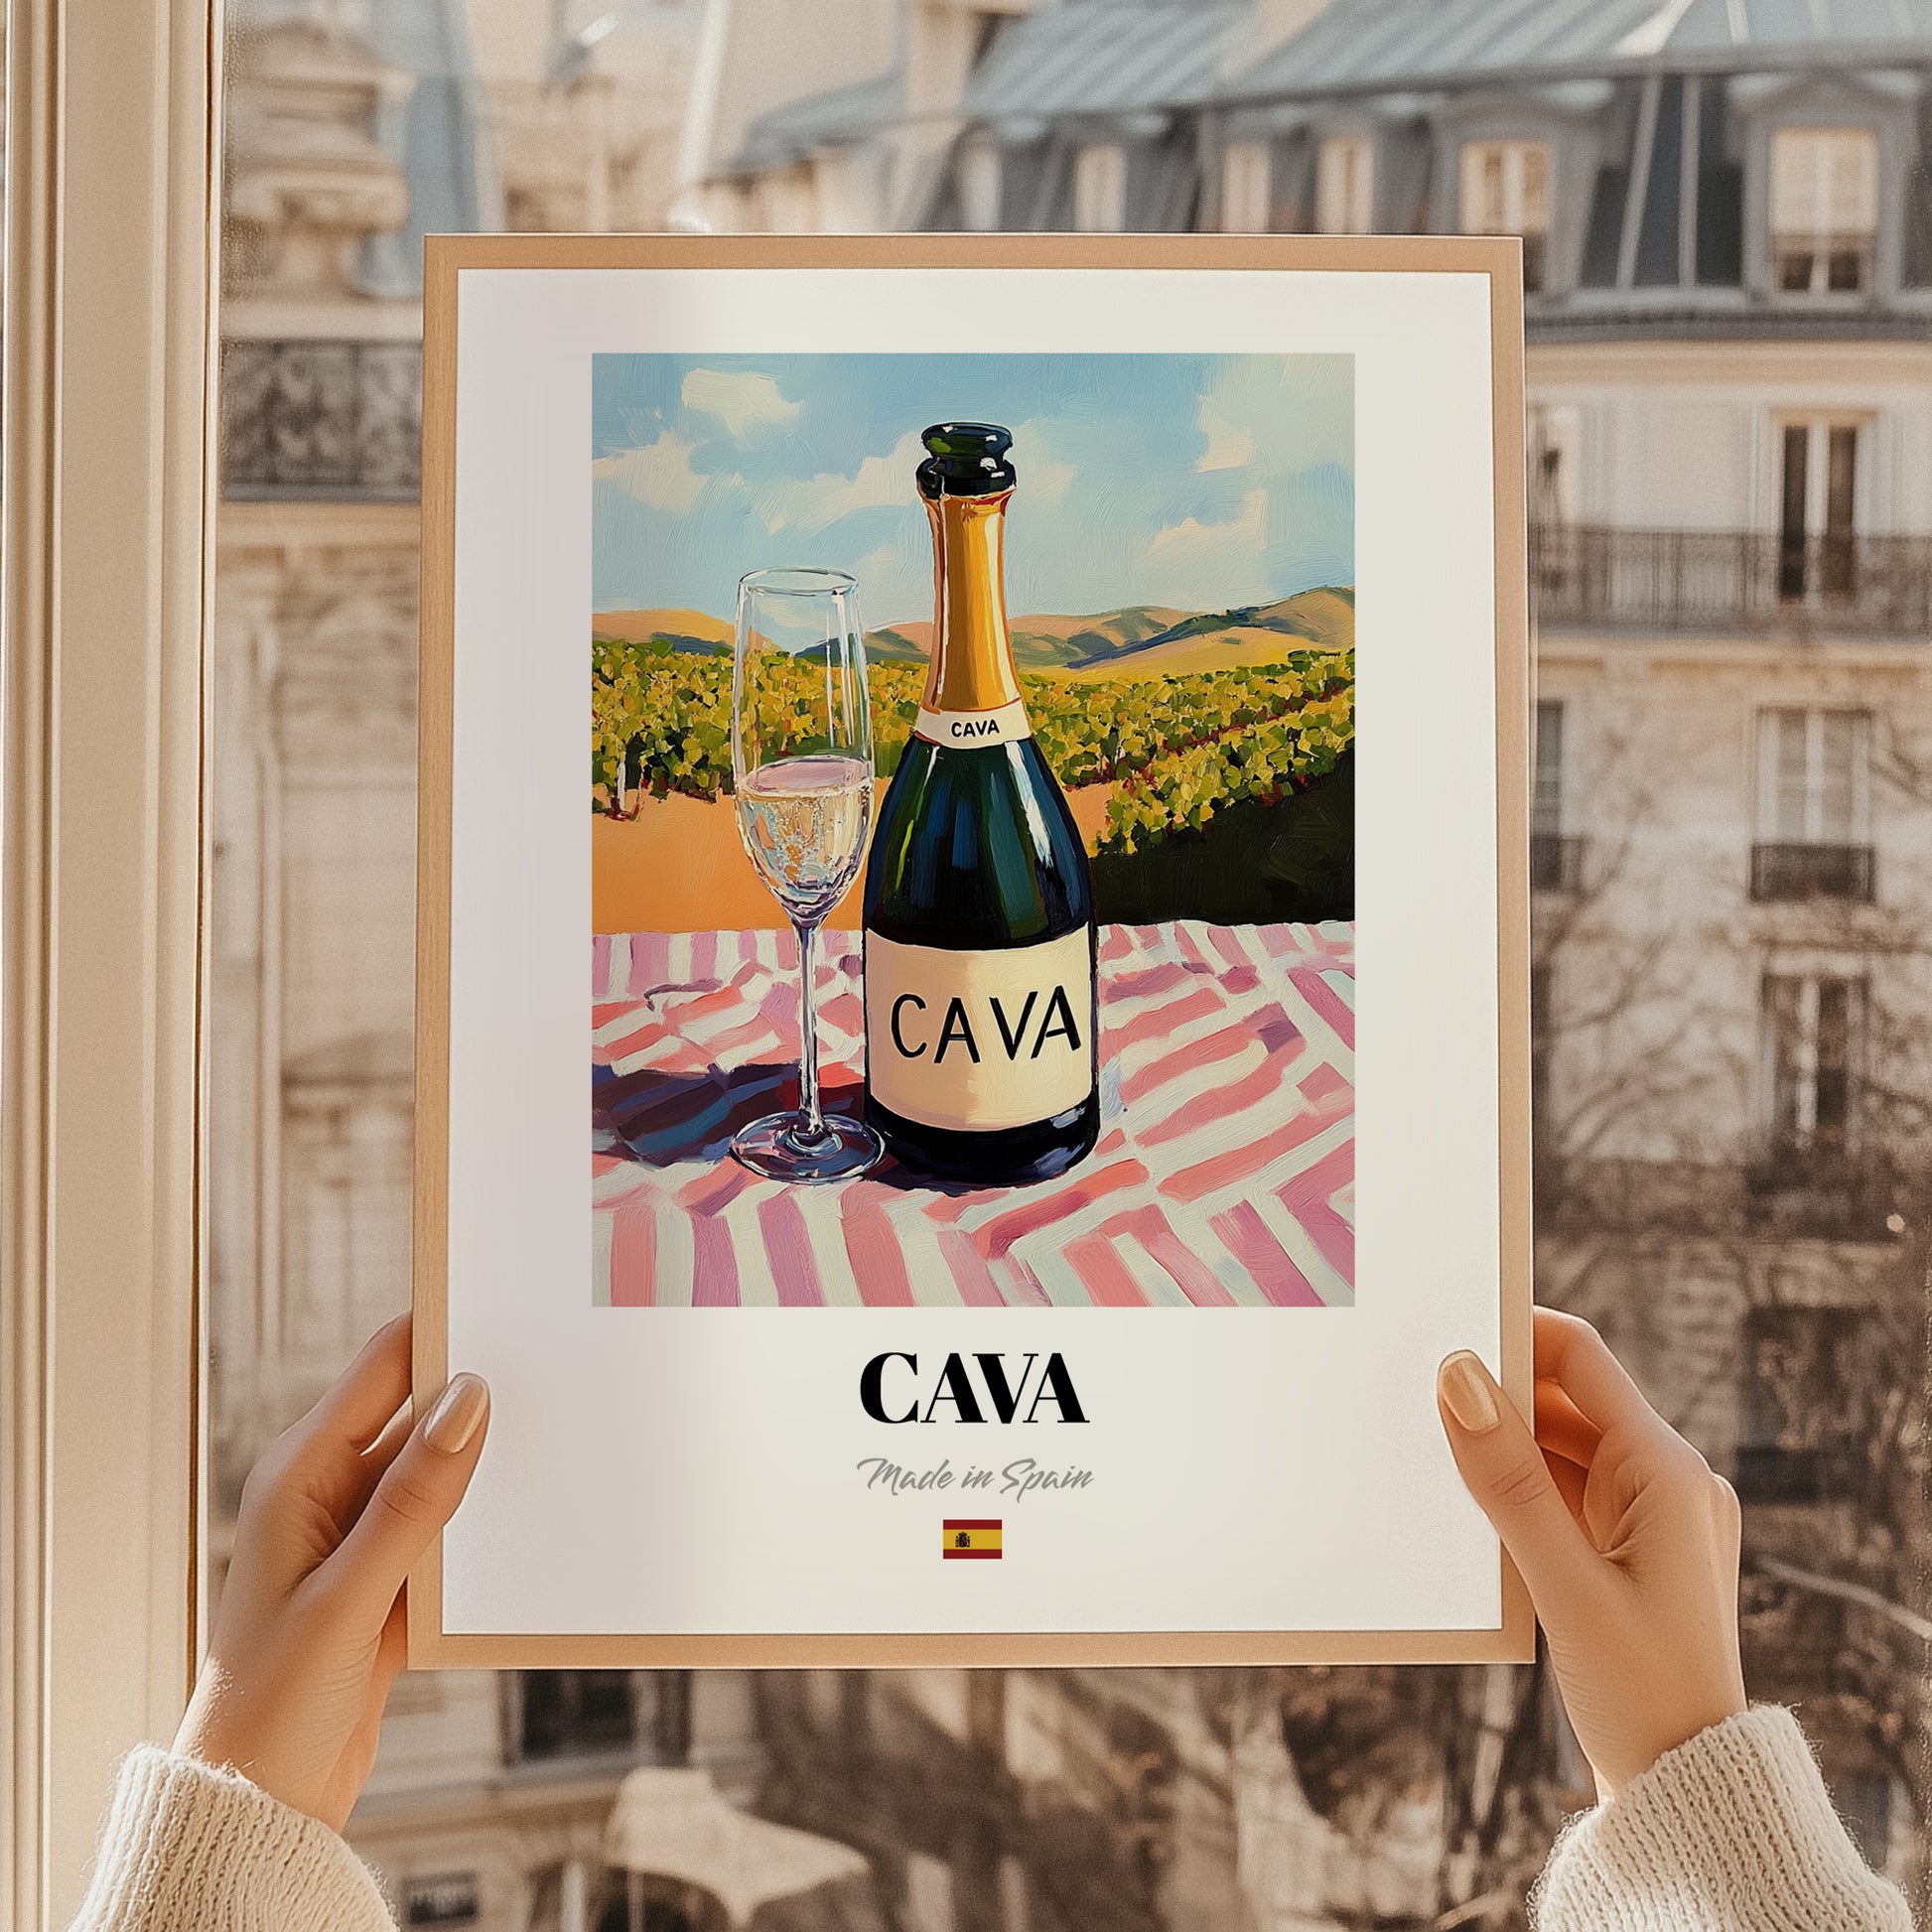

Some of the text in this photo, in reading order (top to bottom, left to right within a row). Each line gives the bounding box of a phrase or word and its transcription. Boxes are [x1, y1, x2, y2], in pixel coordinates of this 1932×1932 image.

[950, 719, 1001, 738] CAVA
[891, 985, 1082, 1064] CAVA
[860, 1351, 1091, 1425] CAVA
[856, 1457, 1095, 1504] Made in Spain
